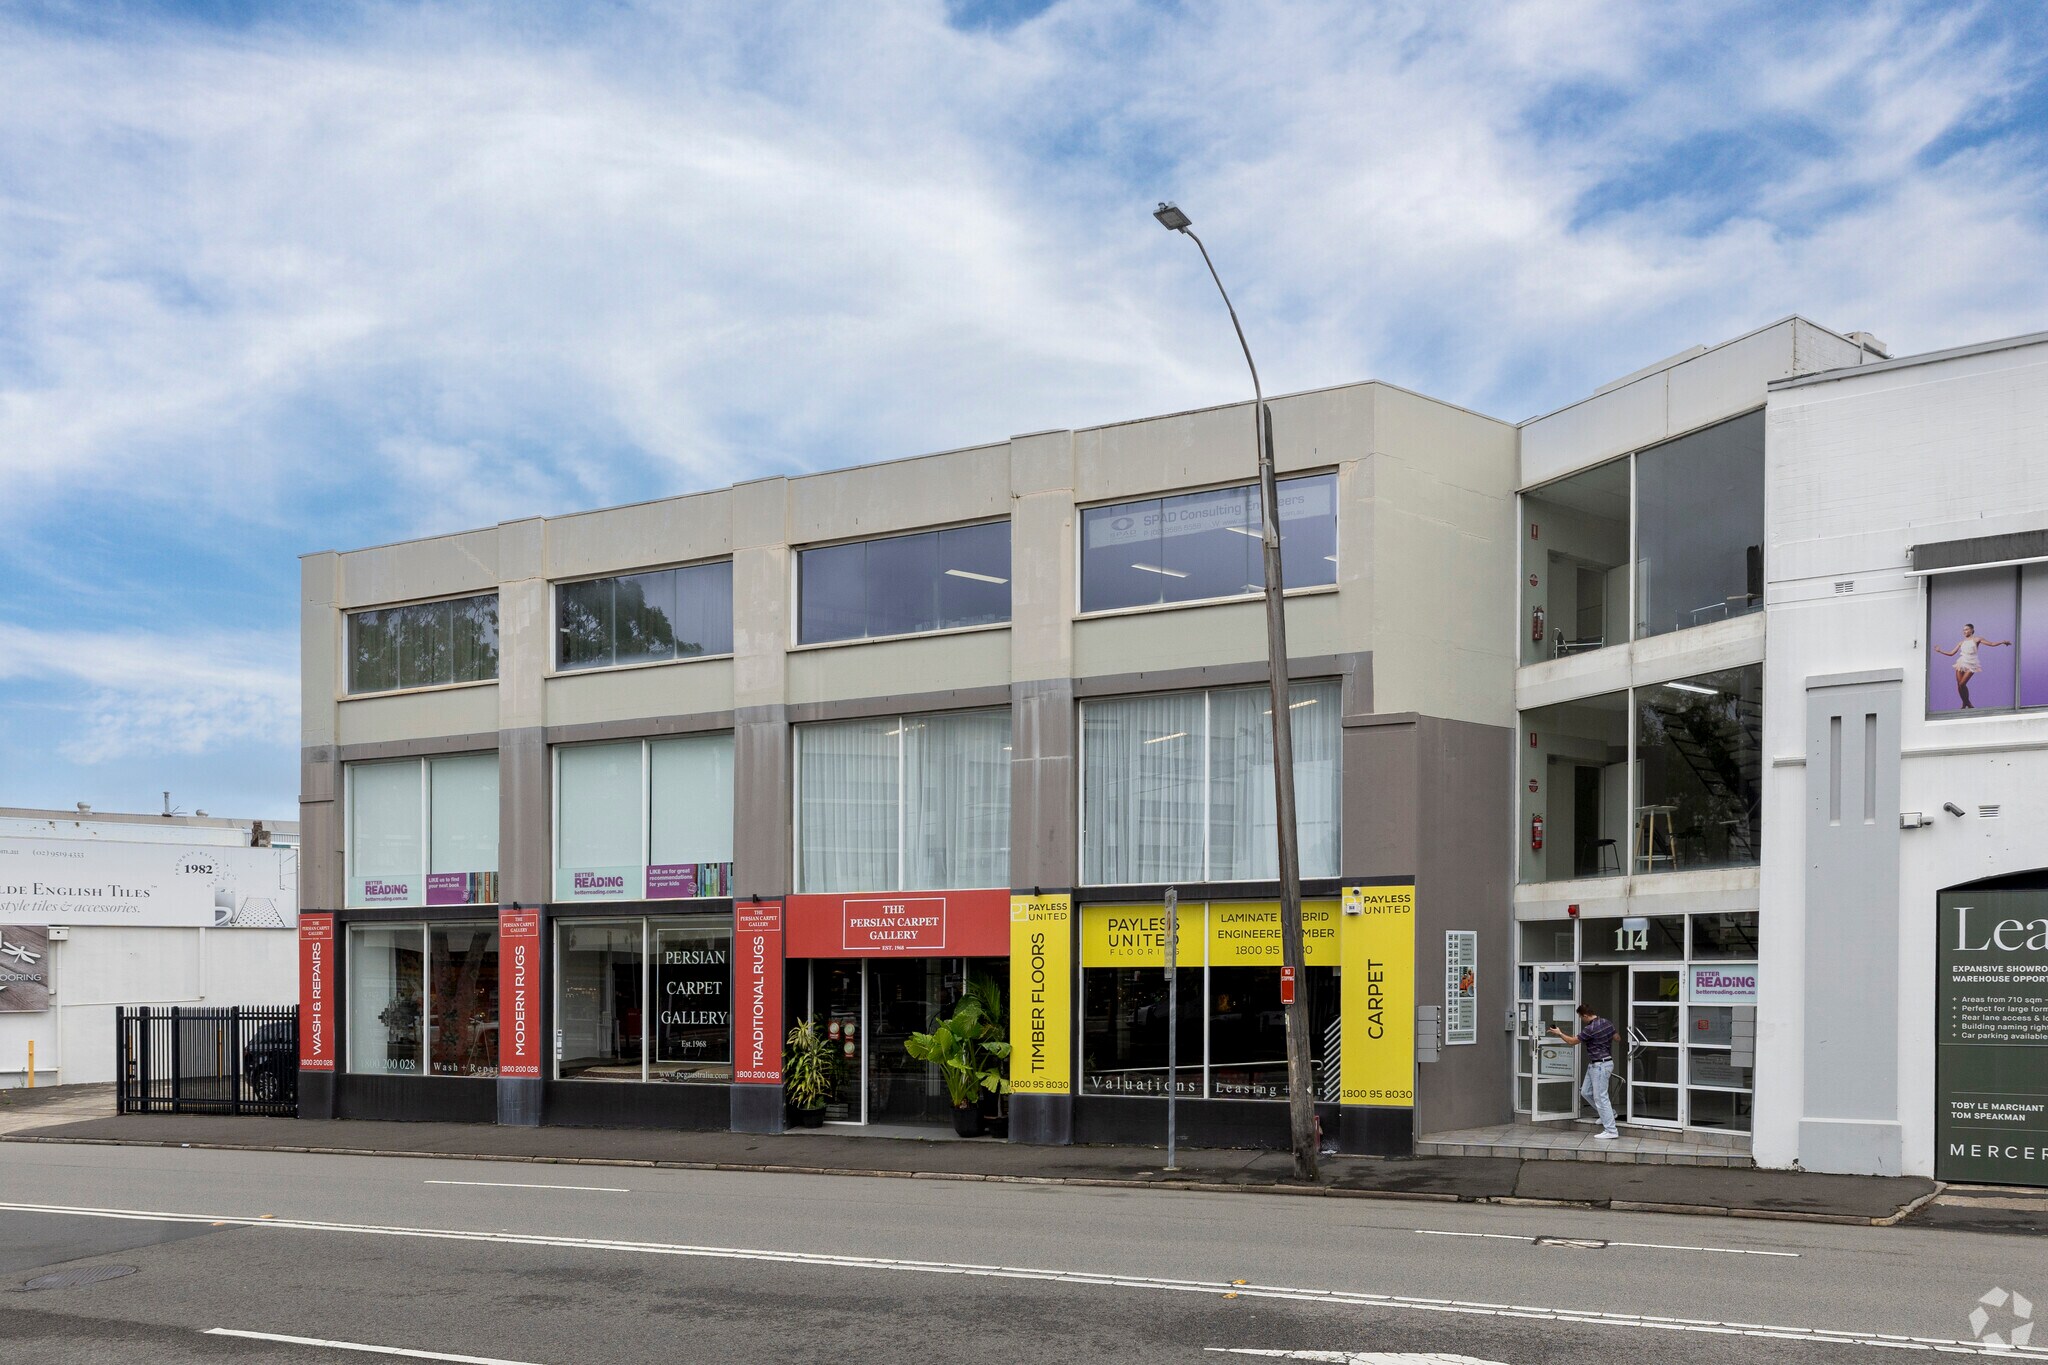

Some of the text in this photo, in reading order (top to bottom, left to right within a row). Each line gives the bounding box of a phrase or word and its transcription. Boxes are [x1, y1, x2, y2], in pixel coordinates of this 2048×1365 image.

[1143, 511, 1177, 526] SPAD
[1180, 504, 1242, 521] Consulting
[1245, 495, 1305, 511] Eneers
[184, 864, 214, 874] 1982
[677, 868, 691, 876] great
[33, 882, 103, 897] ENGLISH
[1363, 894, 1411, 904] PAYLESS
[31, 899, 58, 913] tiles
[74, 902, 141, 914] accessories.
[883, 905, 905, 914] THE
[1028, 902, 1068, 911] PAYLESS
[1363, 905, 1411, 915] UNITED
[1028, 912, 1068, 921] UNITED
[1220, 912, 1329, 923] LAMINATE BRID
[850, 917, 939, 928] PERSIAN CARPET
[1217, 928, 1335, 939] ENGINEERE MBER
[1952, 906, 2048, 951] Lea
[869, 930, 919, 940] GALLERY
[1614, 926, 1649, 951] 114
[753, 936, 765, 974] RUGS
[1110, 948, 1180, 956] FLOORIG
[1235, 945, 1280, 955] 1800 95
[665, 950, 726, 965] PERSIAN
[312, 942, 321, 999] REPAIRS
[515, 945, 525, 986] RUGS
[1952, 965, 2048, 973] EXPANSIVE SHOWRO
[1952, 975, 2048, 983] WAREHOUSE OPPOR
[666, 981, 723, 995] CARPET
[1031, 932, 1045, 1073] TIMBER FLOORS
[1368, 959, 1383, 1040] CARPET
[2024, 997, 2043, 1005] sqm
[312, 1001, 321, 1011] &
[2007, 1005, 2029, 1014] large
[660, 1010, 728, 1025] GALLERY
[753, 976, 764, 1069] TRADITIONAL
[515, 990, 525, 1056] MODERN
[1961, 1023, 1995, 1031] Building
[1997, 1024, 2028, 1032] naming
[312, 1013, 321, 1056] WASH
[1977, 1032, 2009, 1040] parking
[382, 1058, 398, 1070] 200
[399, 1058, 416, 1070] 028
[433, 1062, 458, 1072] Wash
[501, 1065, 515, 1073] 1800
[660, 1070, 729, 1080] www.pcgaustralia.com
[736, 1070, 780, 1079] 1800 200 028
[1010, 1080, 1069, 1089] 1800 95 8030
[1091, 1076, 1196, 1092] Valuations
[1215, 1082, 1277, 1096] Leasing
[1342, 1089, 1367, 1098] 1800
[1369, 1089, 1383, 1098] 95
[1385, 1089, 1413, 1099] 8030
[1951, 1101, 2045, 1112] TOBY LE MARCHANT
[1951, 1111, 2026, 1121] TOM SPEAKMAN
